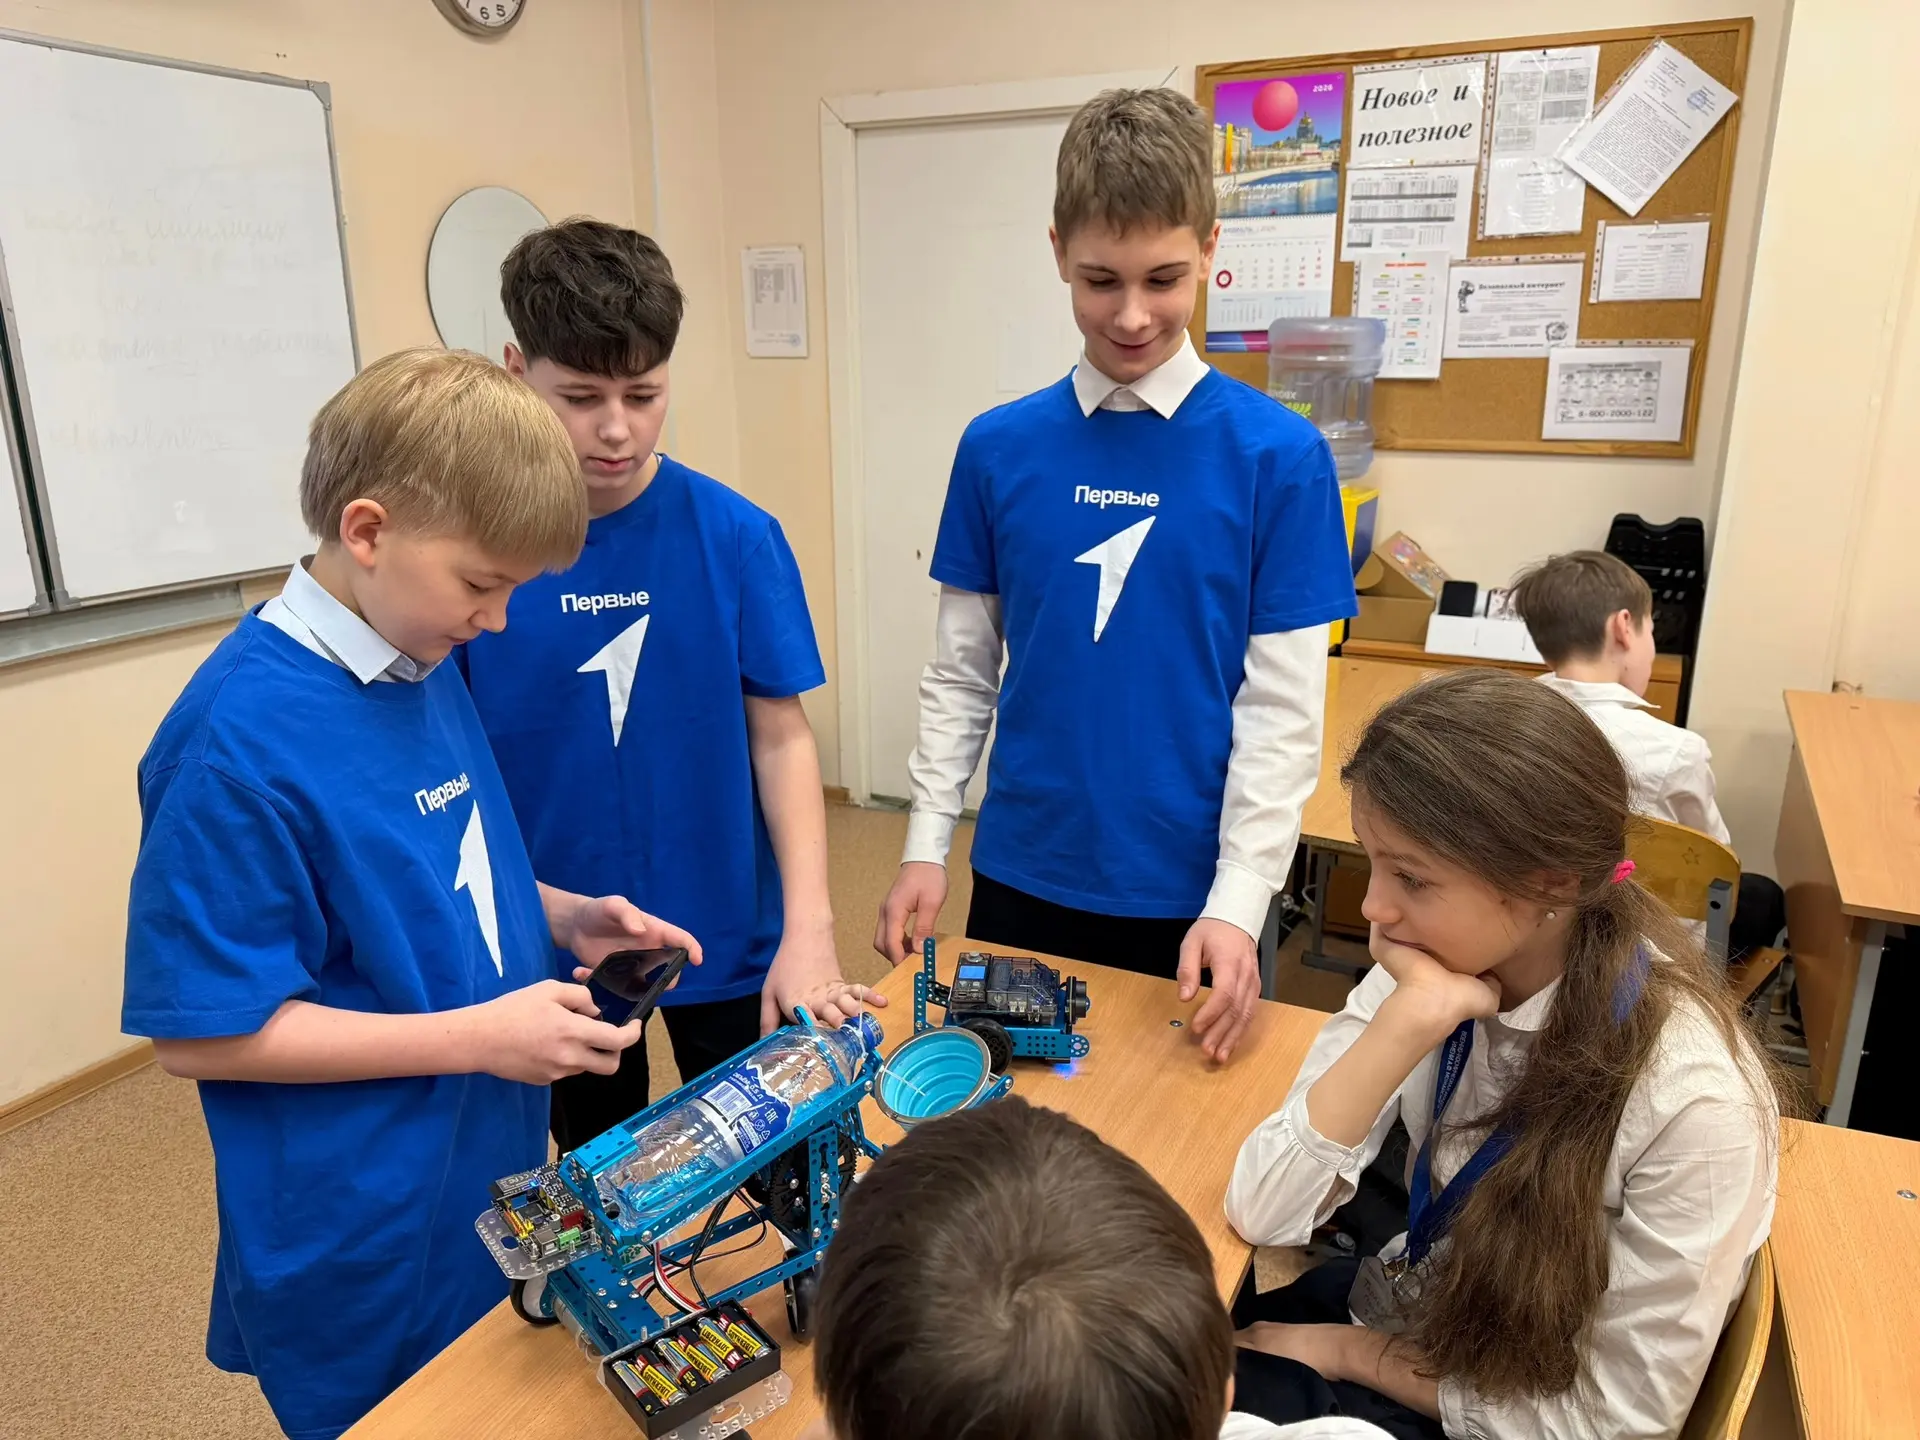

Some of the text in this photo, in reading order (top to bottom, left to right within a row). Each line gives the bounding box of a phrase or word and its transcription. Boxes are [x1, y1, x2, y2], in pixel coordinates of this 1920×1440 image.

[480, 6, 490, 20] 6
[496, 4, 506, 17] 5
[1312, 84, 1334, 92] 2026
[1359, 85, 1469, 111] Новое и
[1358, 122, 1473, 147] полезное
[1074, 485, 1160, 509] Первые
[560, 591, 650, 616] Первые
[414, 772, 470, 816] Первые
[702, 1328, 730, 1353] LIBERHAUS
[729, 1329, 755, 1354] LIBERHAUS
[727, 1351, 741, 1365] AA
[645, 1370, 671, 1397] LIBERHAUS
